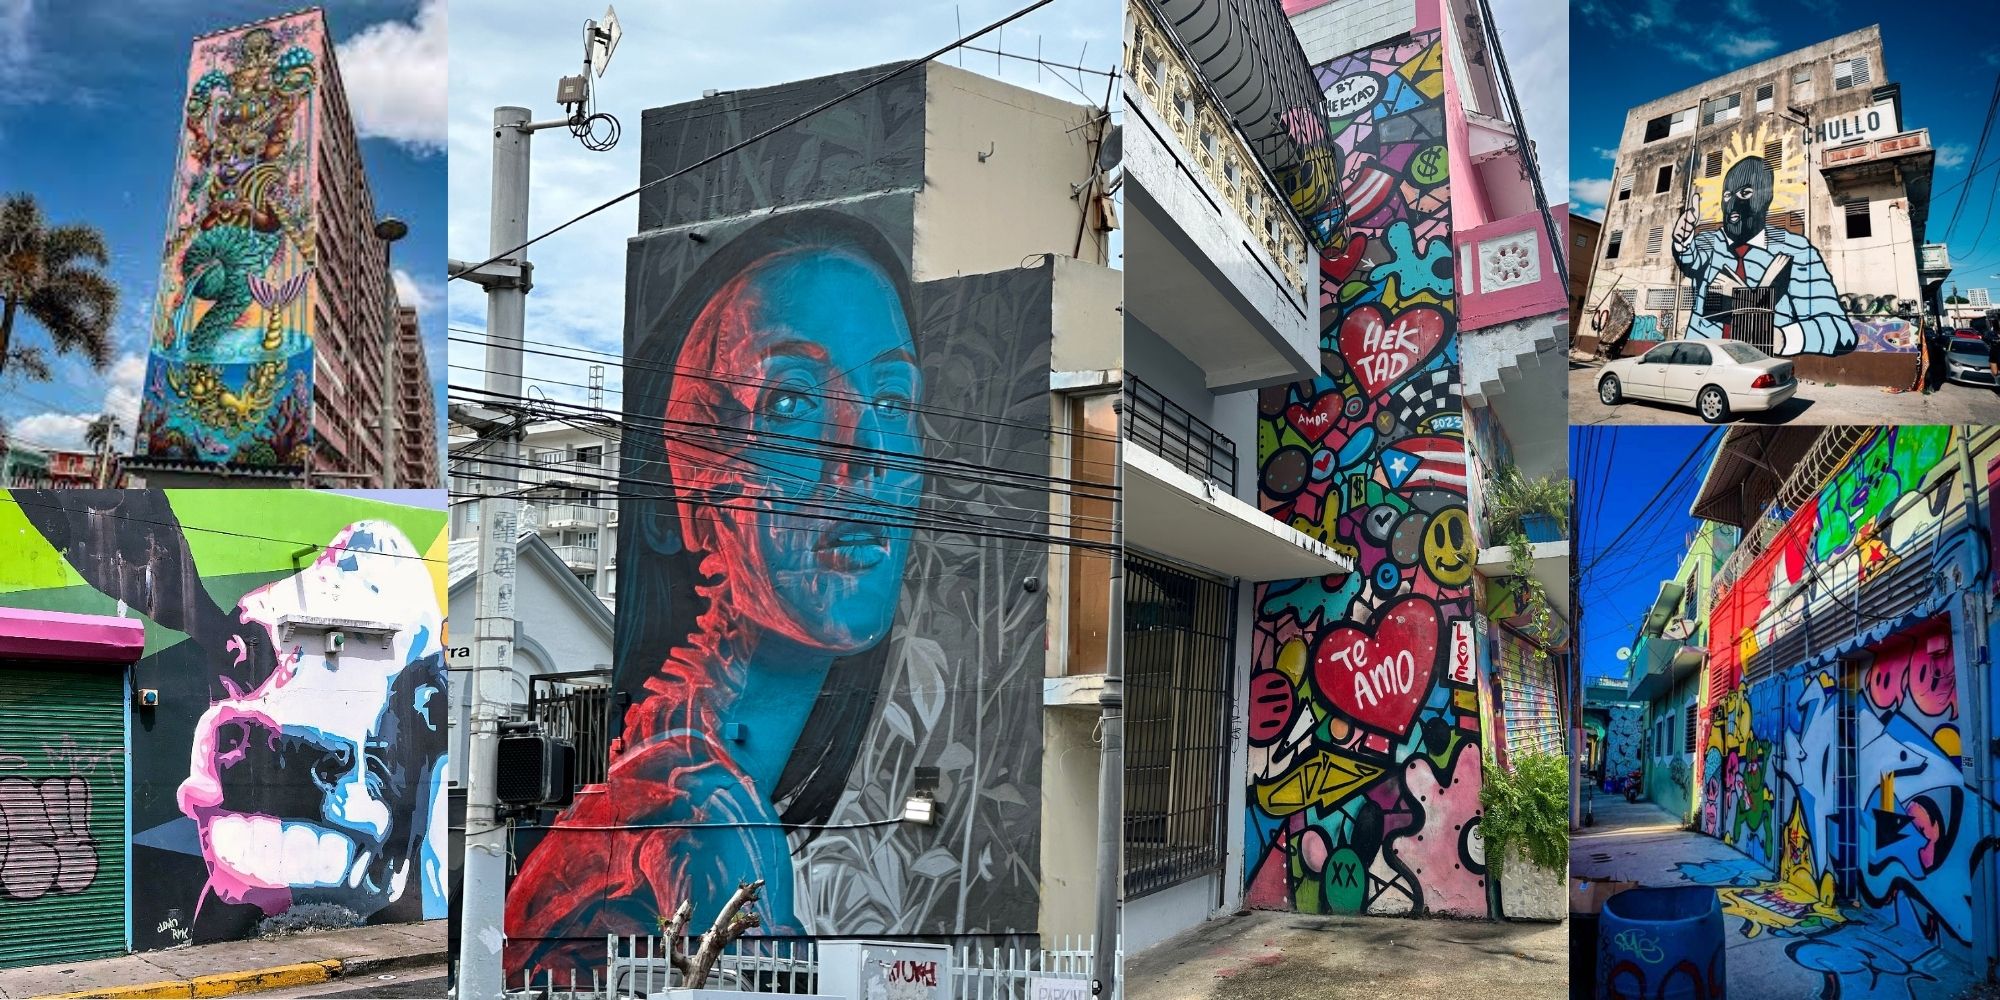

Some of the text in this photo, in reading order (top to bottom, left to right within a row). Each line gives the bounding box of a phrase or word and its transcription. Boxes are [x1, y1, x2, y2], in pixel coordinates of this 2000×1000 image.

[1326, 85, 1376, 112] HEKTAD
[1336, 79, 1355, 94] BY
[1803, 111, 1880, 145] CHULLO
[1363, 320, 1419, 354] HEK
[1356, 352, 1408, 385] TAD
[1298, 412, 1328, 425] AMOR
[1431, 416, 1463, 430] 2023
[448, 646, 470, 658] ra
[1454, 623, 1469, 682] LOVE
[1354, 649, 1415, 710] AMO
